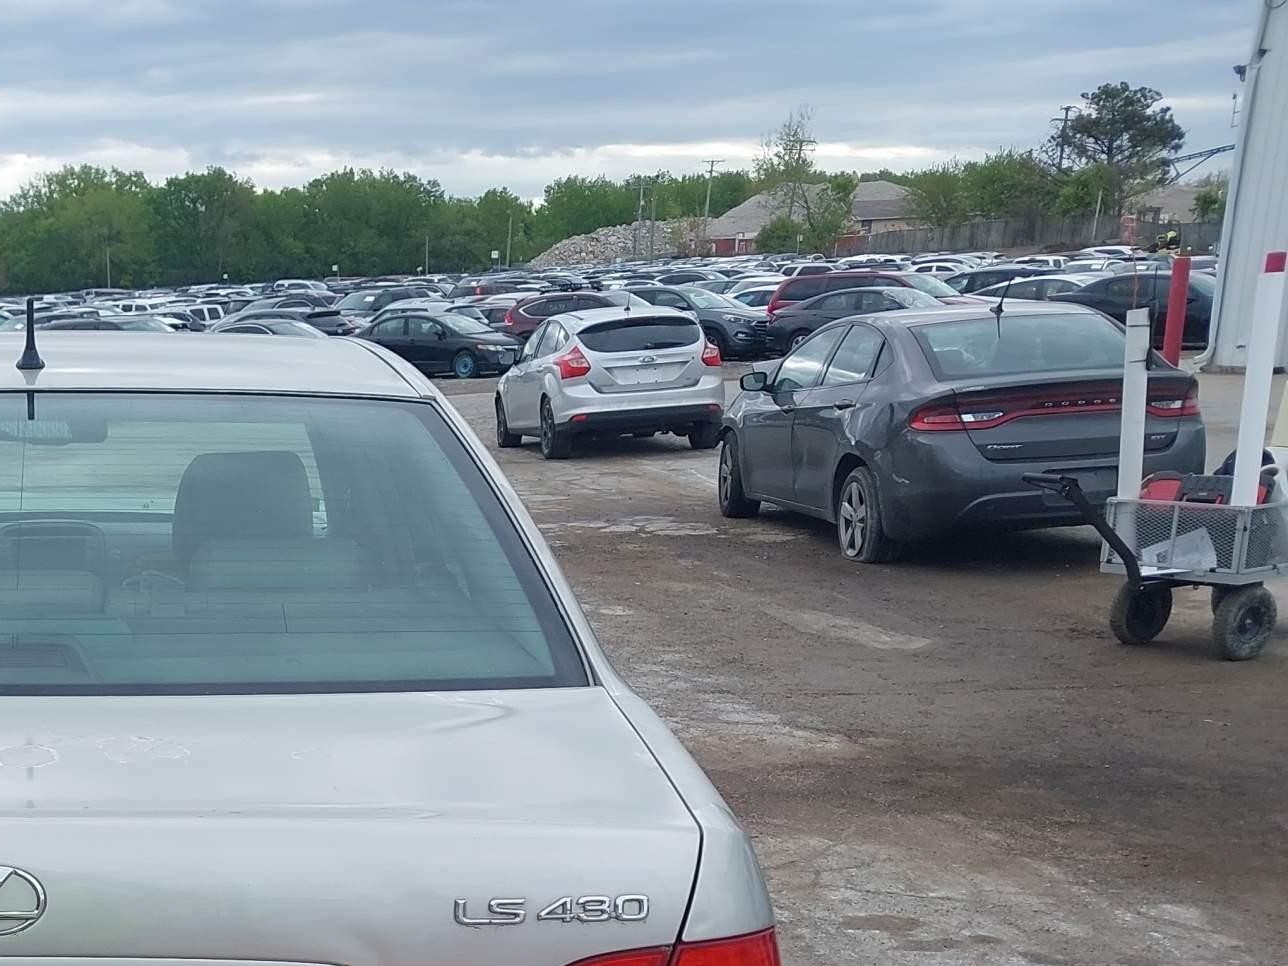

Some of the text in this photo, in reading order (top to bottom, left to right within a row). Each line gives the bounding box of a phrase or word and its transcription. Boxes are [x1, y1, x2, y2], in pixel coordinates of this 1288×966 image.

[1044, 398, 1117, 407] DODGE
[454, 894, 649, 925] LS 430
